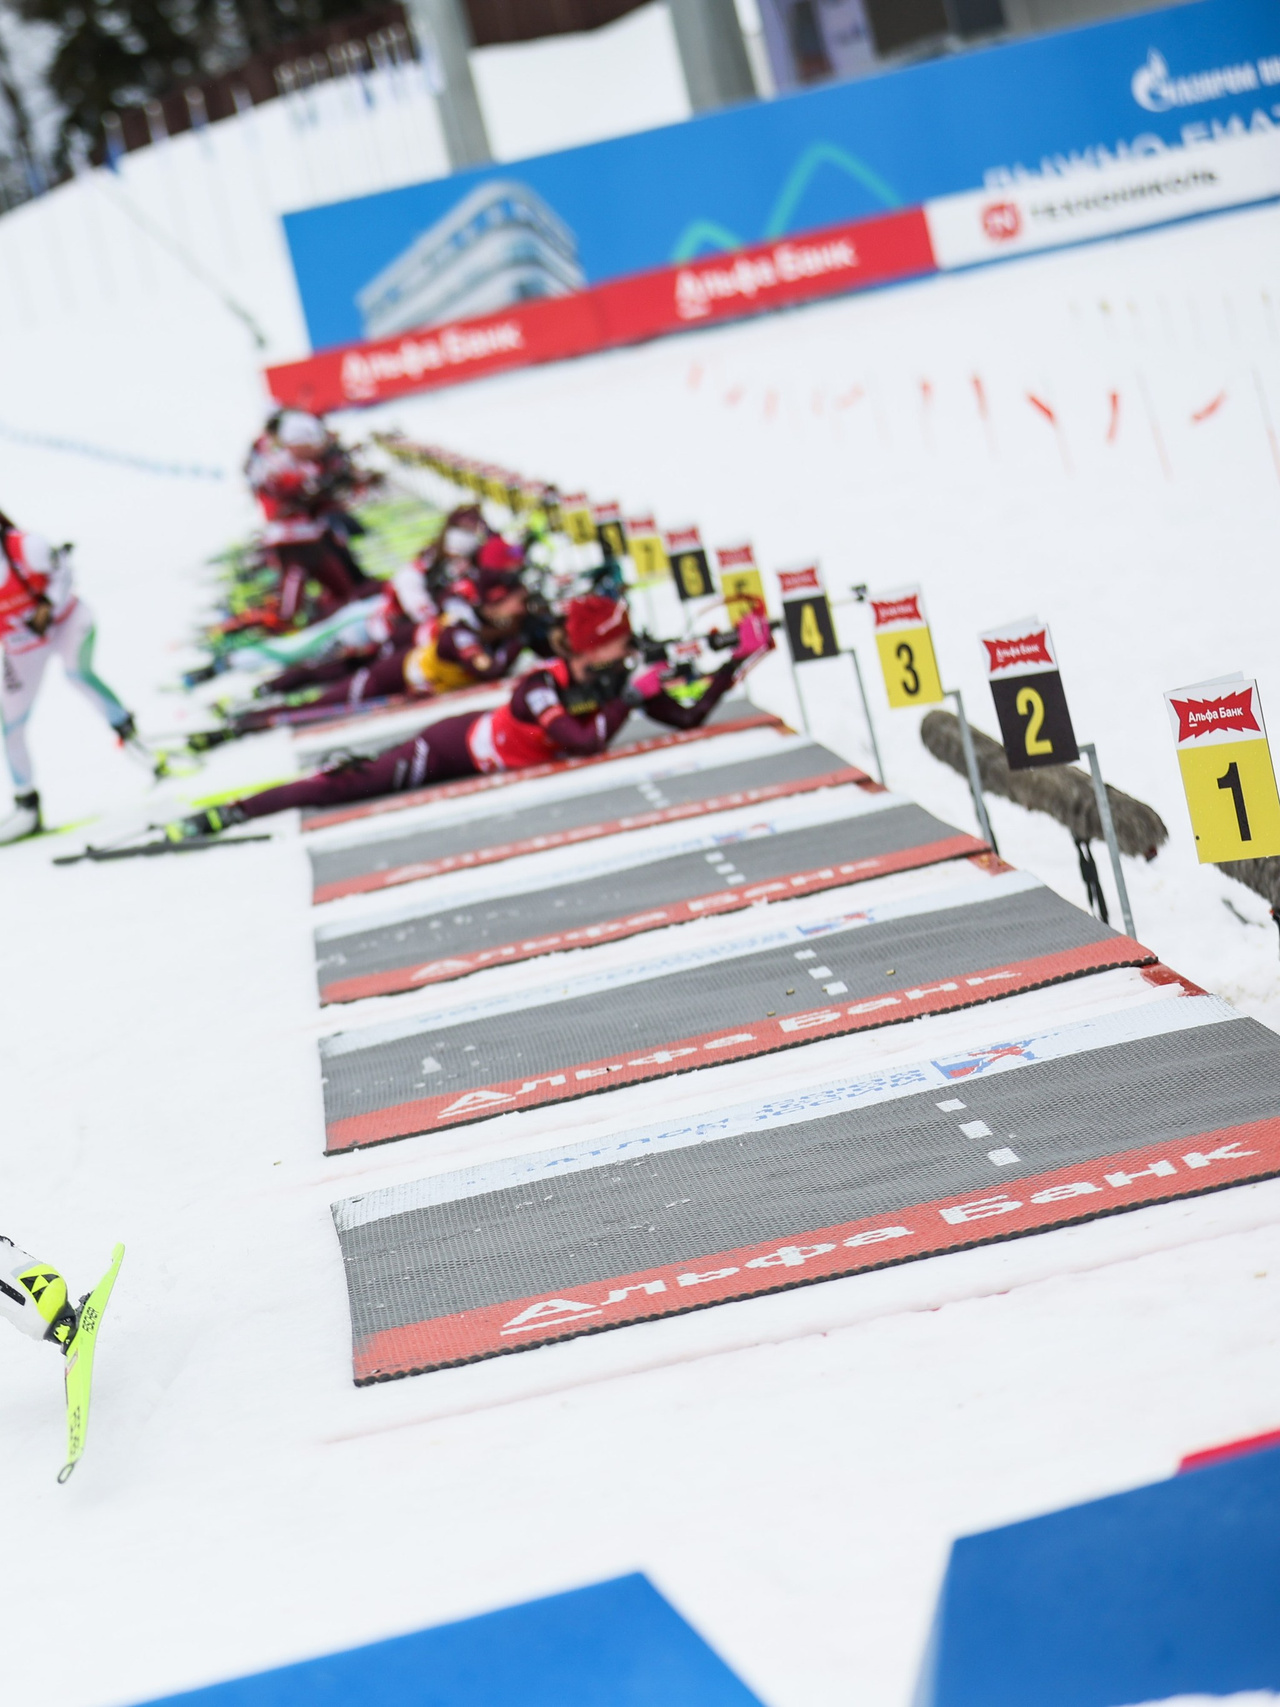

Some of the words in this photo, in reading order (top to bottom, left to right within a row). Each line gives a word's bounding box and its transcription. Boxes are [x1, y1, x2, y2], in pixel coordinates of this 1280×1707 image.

[799, 603, 824, 656] 4
[895, 641, 921, 697] 3
[1016, 687, 1053, 756] 2
[1188, 709, 1219, 727] Альфа
[1218, 707, 1243, 718] Банк
[1217, 762, 1252, 842] 1
[437, 1033, 757, 1119] Альфа
[779, 970, 1023, 1033] Банк
[500, 1225, 914, 1336] Альфа
[939, 1141, 1261, 1225] Банк
